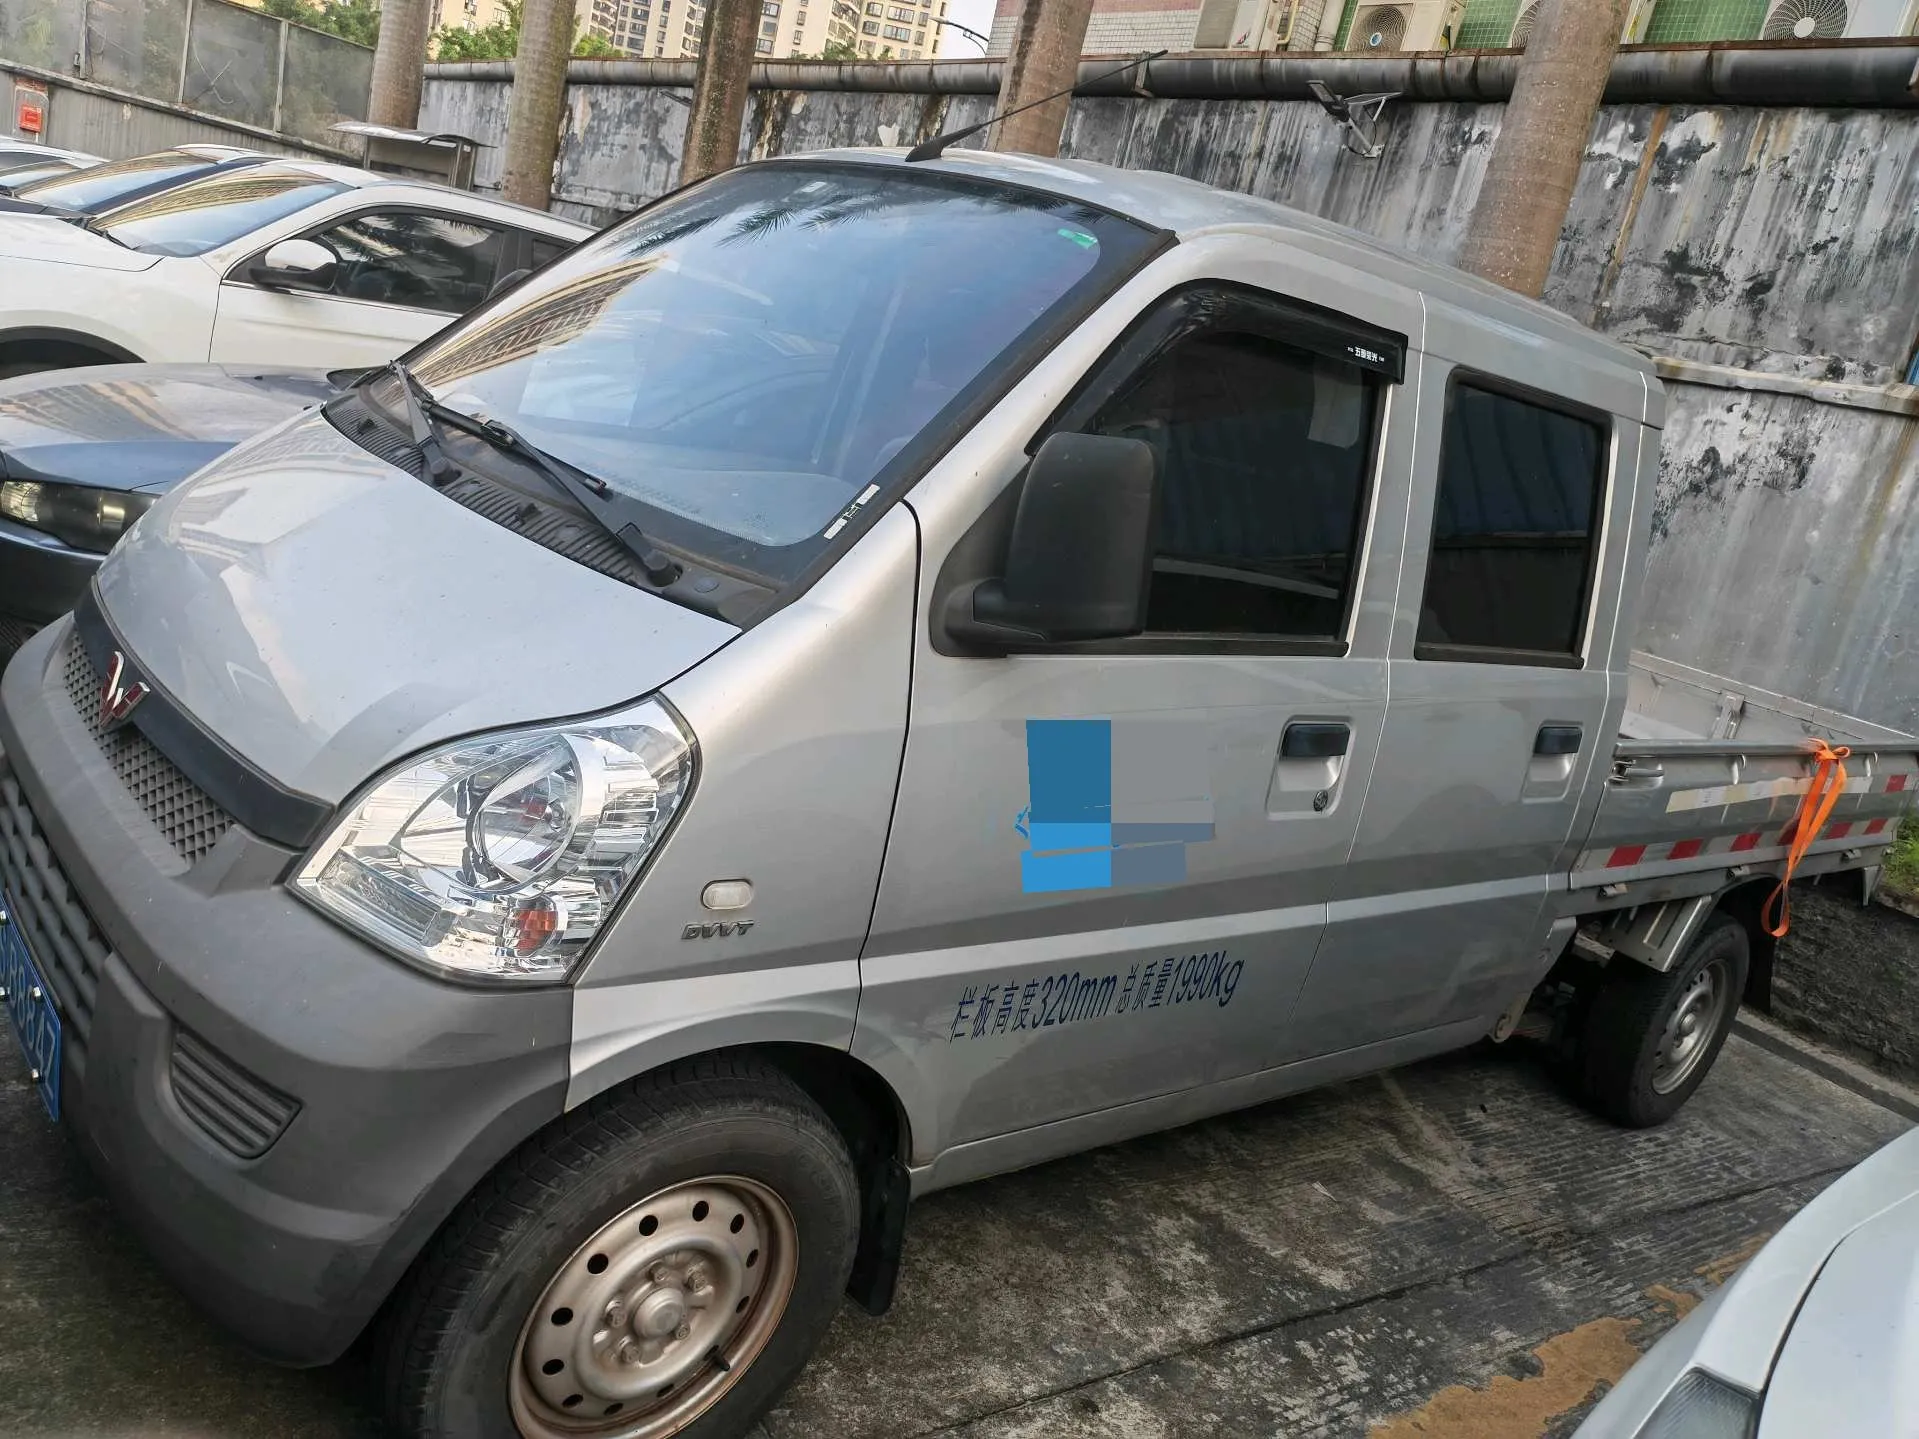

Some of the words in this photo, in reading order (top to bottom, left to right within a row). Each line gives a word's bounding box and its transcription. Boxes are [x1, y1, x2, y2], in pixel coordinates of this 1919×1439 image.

[681, 919, 754, 940] DVVT
[949, 971, 1118, 1044] 栏板高度320mm
[1114, 950, 1246, 1014] 总质量1990kg
